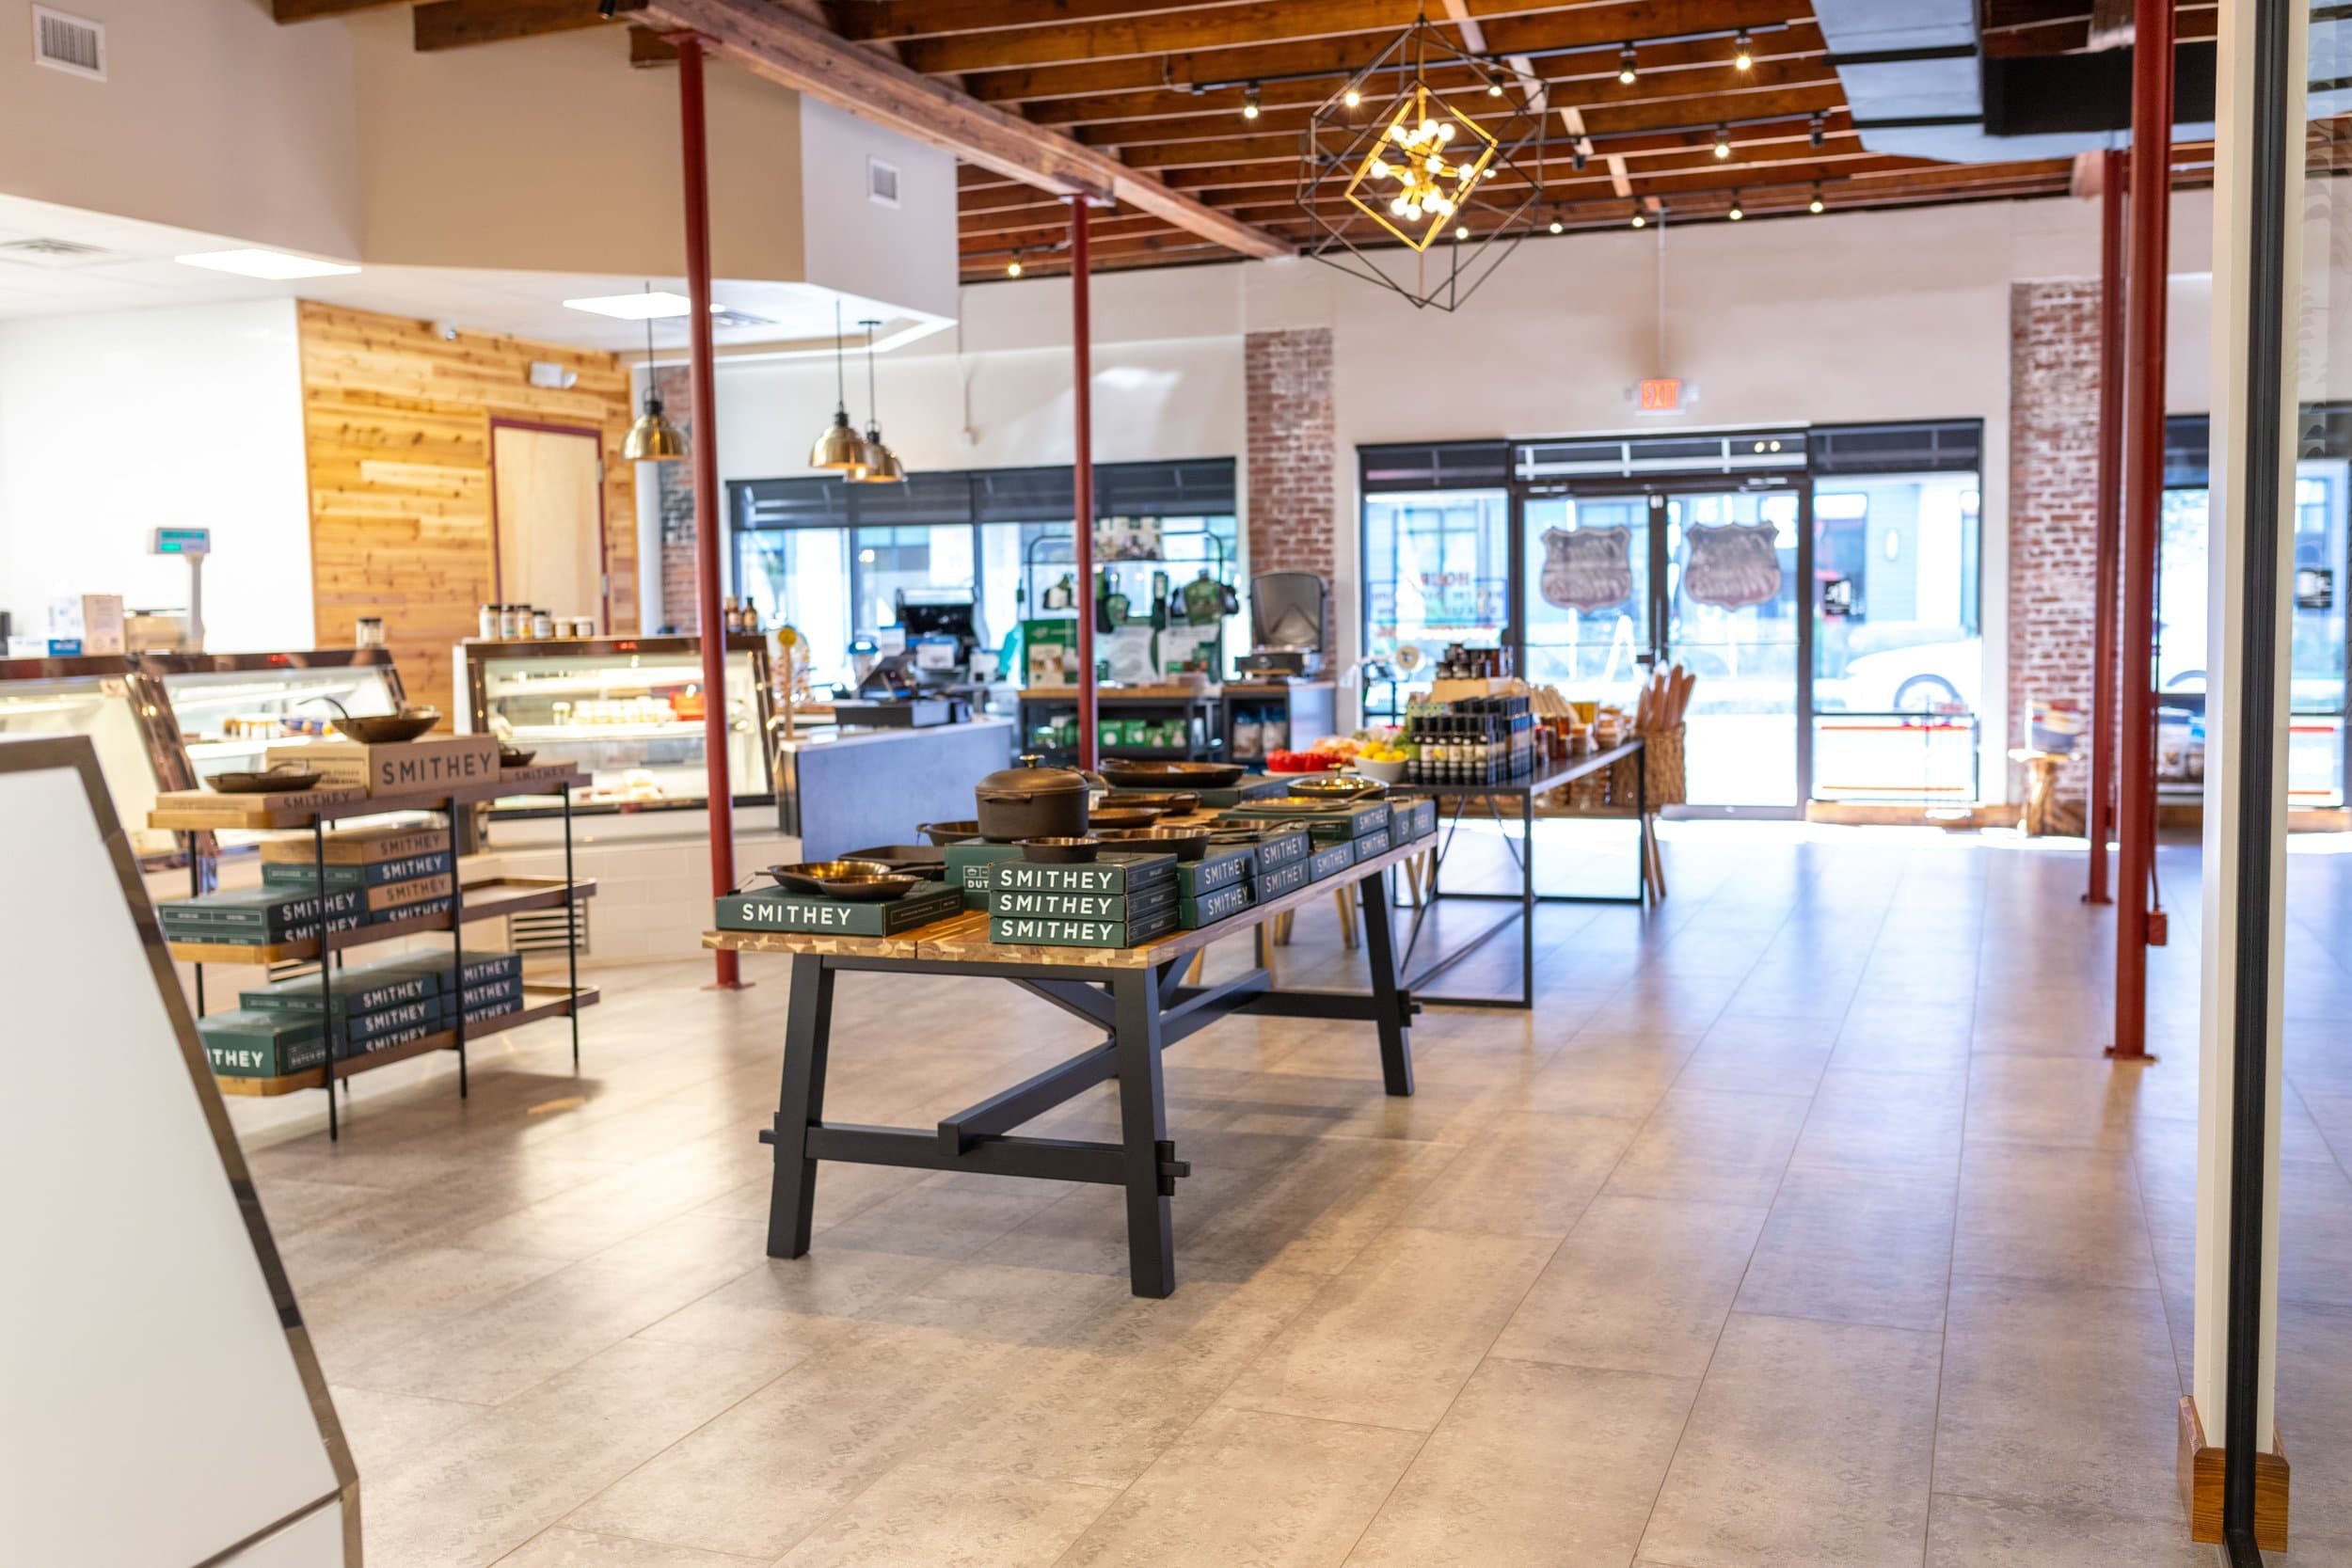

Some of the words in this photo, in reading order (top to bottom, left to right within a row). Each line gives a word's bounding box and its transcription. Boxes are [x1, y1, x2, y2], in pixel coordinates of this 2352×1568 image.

[1643, 381, 1678, 408] EXIT
[382, 752, 491, 784] SMITHEY
[283, 791, 351, 809] SMITHEY
[1359, 808, 1389, 830] SMITHEY
[380, 833, 441, 856] SMITHEY
[1264, 834, 1303, 864] SMITHEY
[1362, 832, 1390, 855] SMITHEY
[382, 855, 442, 880] SMITHEY
[1204, 857, 1246, 885] SMITHEY
[1317, 848, 1347, 873] SMITHEY
[387, 878, 446, 902] SMITHEY
[1000, 869, 1113, 889] SMITHEY
[1264, 863, 1304, 893] SMITHEY
[282, 891, 356, 922] SMITHEY
[999, 895, 1113, 915] SMITHEY
[1208, 886, 1248, 916] SMITHEY
[742, 903, 851, 926] SMITHEY
[285, 915, 358, 942] SMIHEY
[1000, 920, 1114, 941] SMITHEY
[464, 958, 510, 982] MITHEY
[363, 979, 423, 1008] SMITHEY
[464, 979, 511, 1005] MITHEY
[365, 1001, 425, 1032] SMITHEY
[465, 1002, 513, 1024] MITHEY
